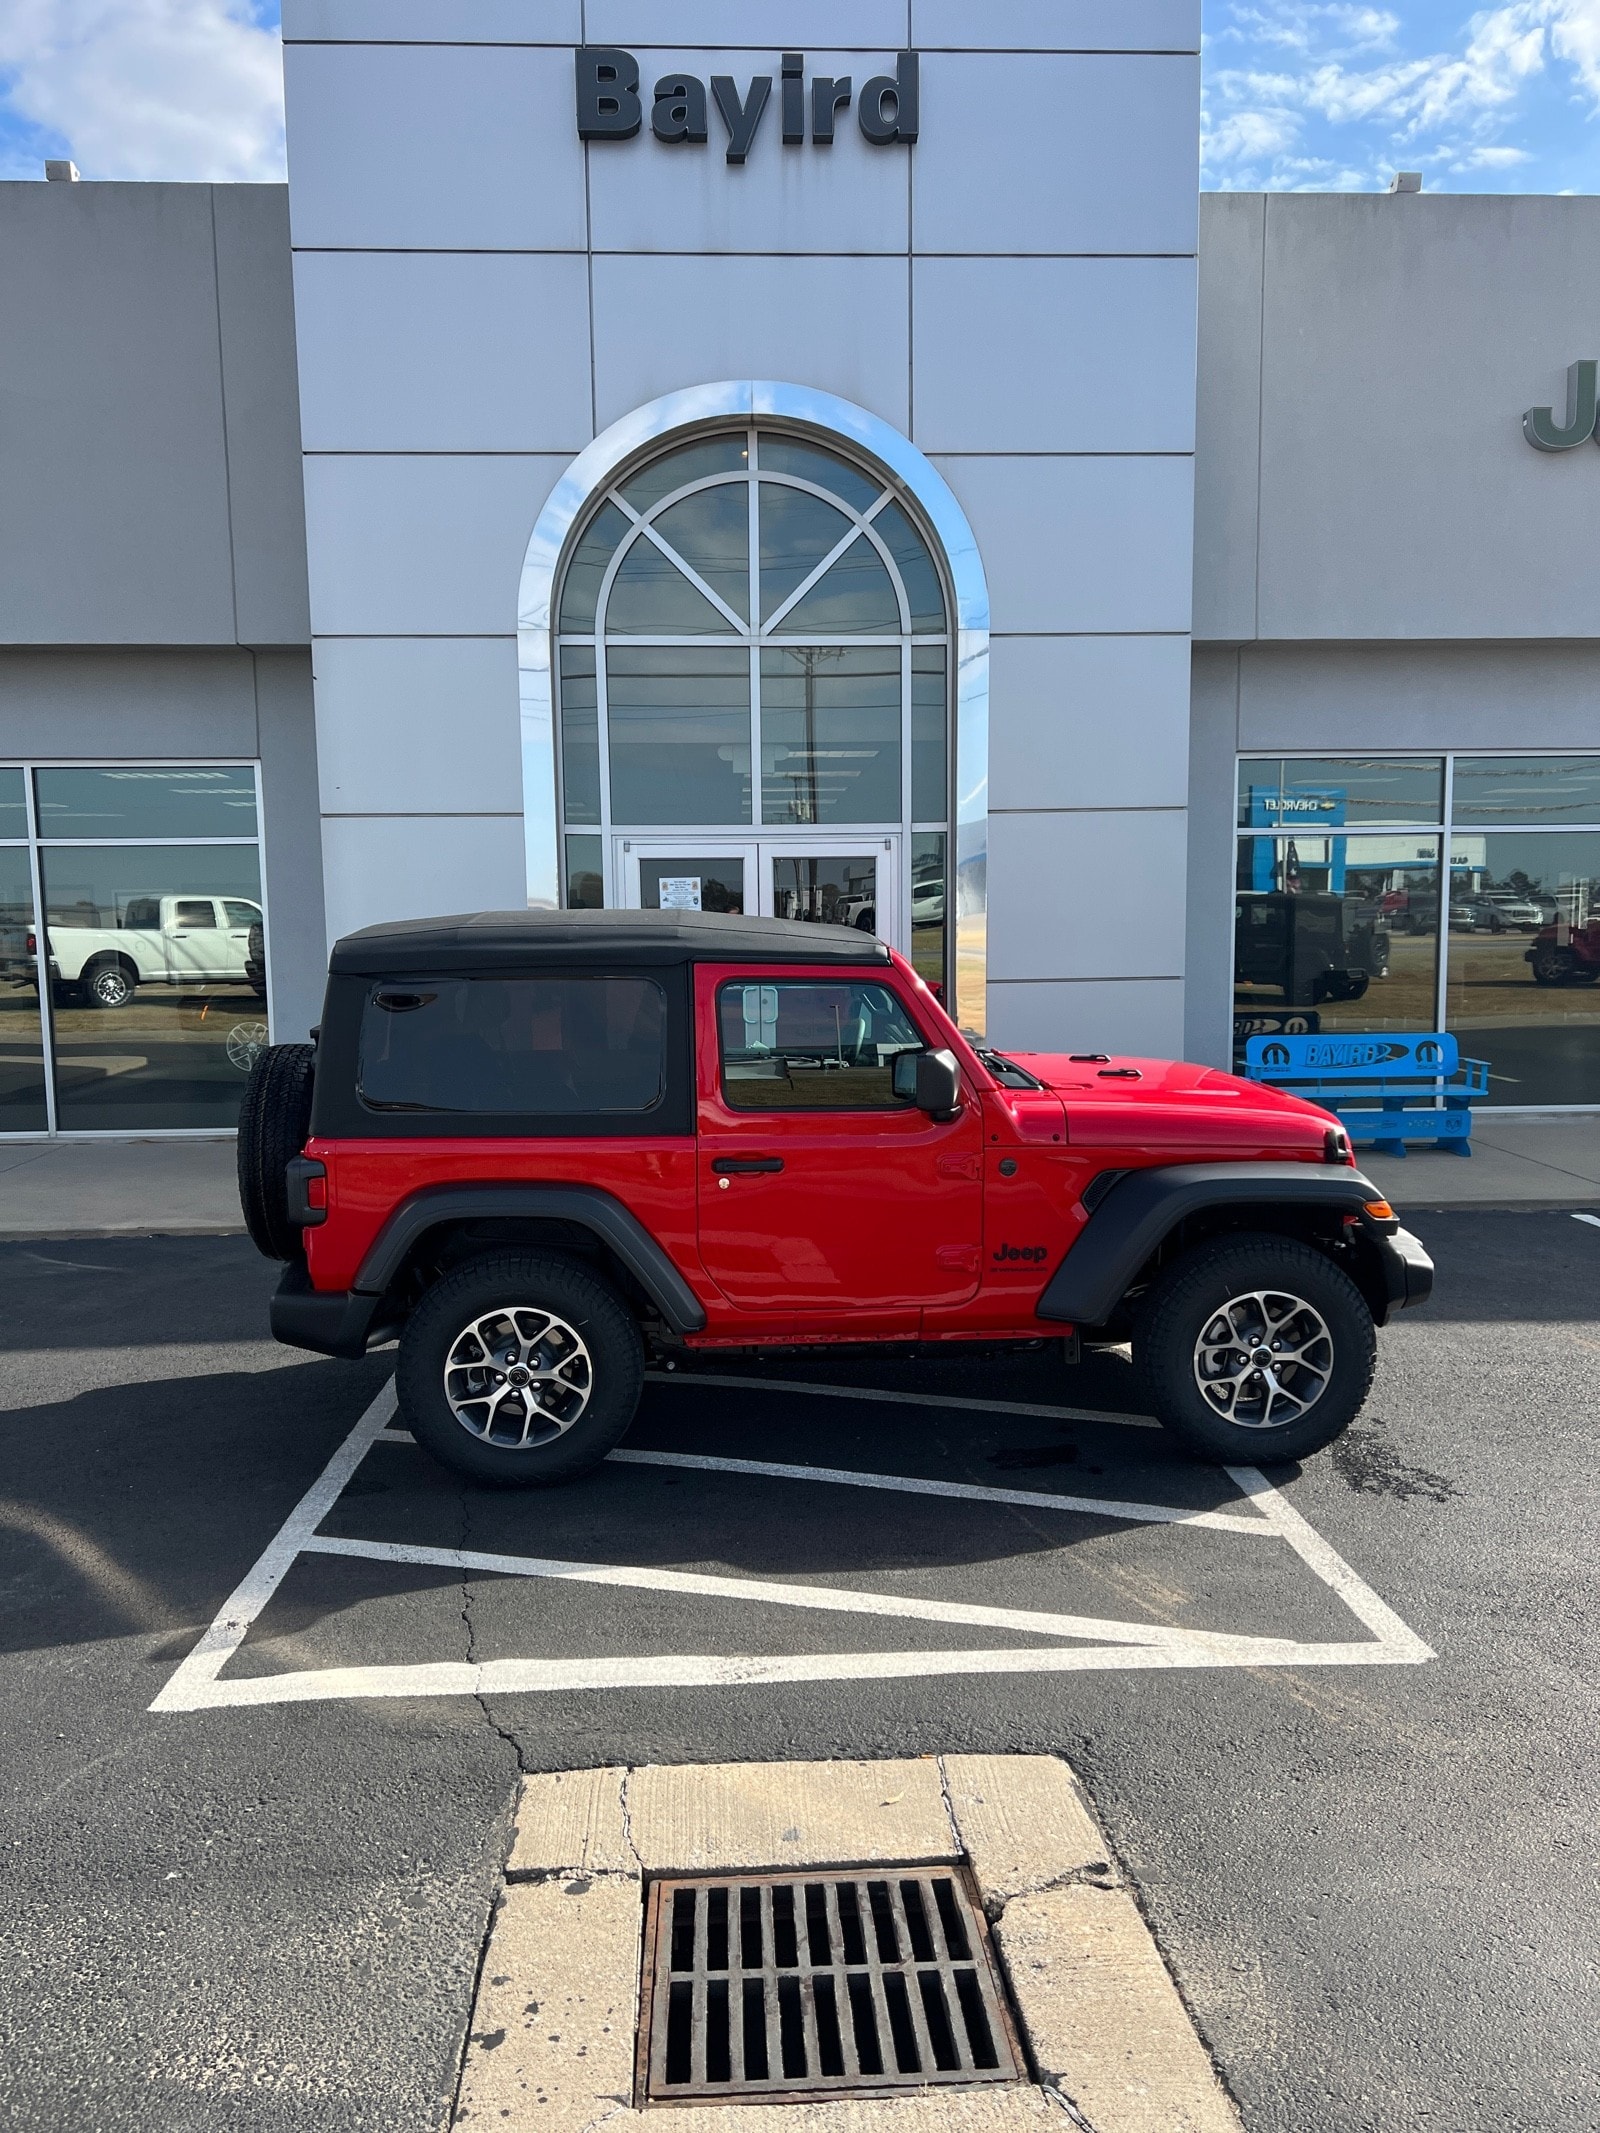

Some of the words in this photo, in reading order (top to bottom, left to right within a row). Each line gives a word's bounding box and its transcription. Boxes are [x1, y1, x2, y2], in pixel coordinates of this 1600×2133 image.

[575, 49, 919, 164] Bayird
[1522, 359, 1600, 453] J
[1305, 1043, 1381, 1067] BAYIRD
[993, 1243, 1048, 1264] Jeep
